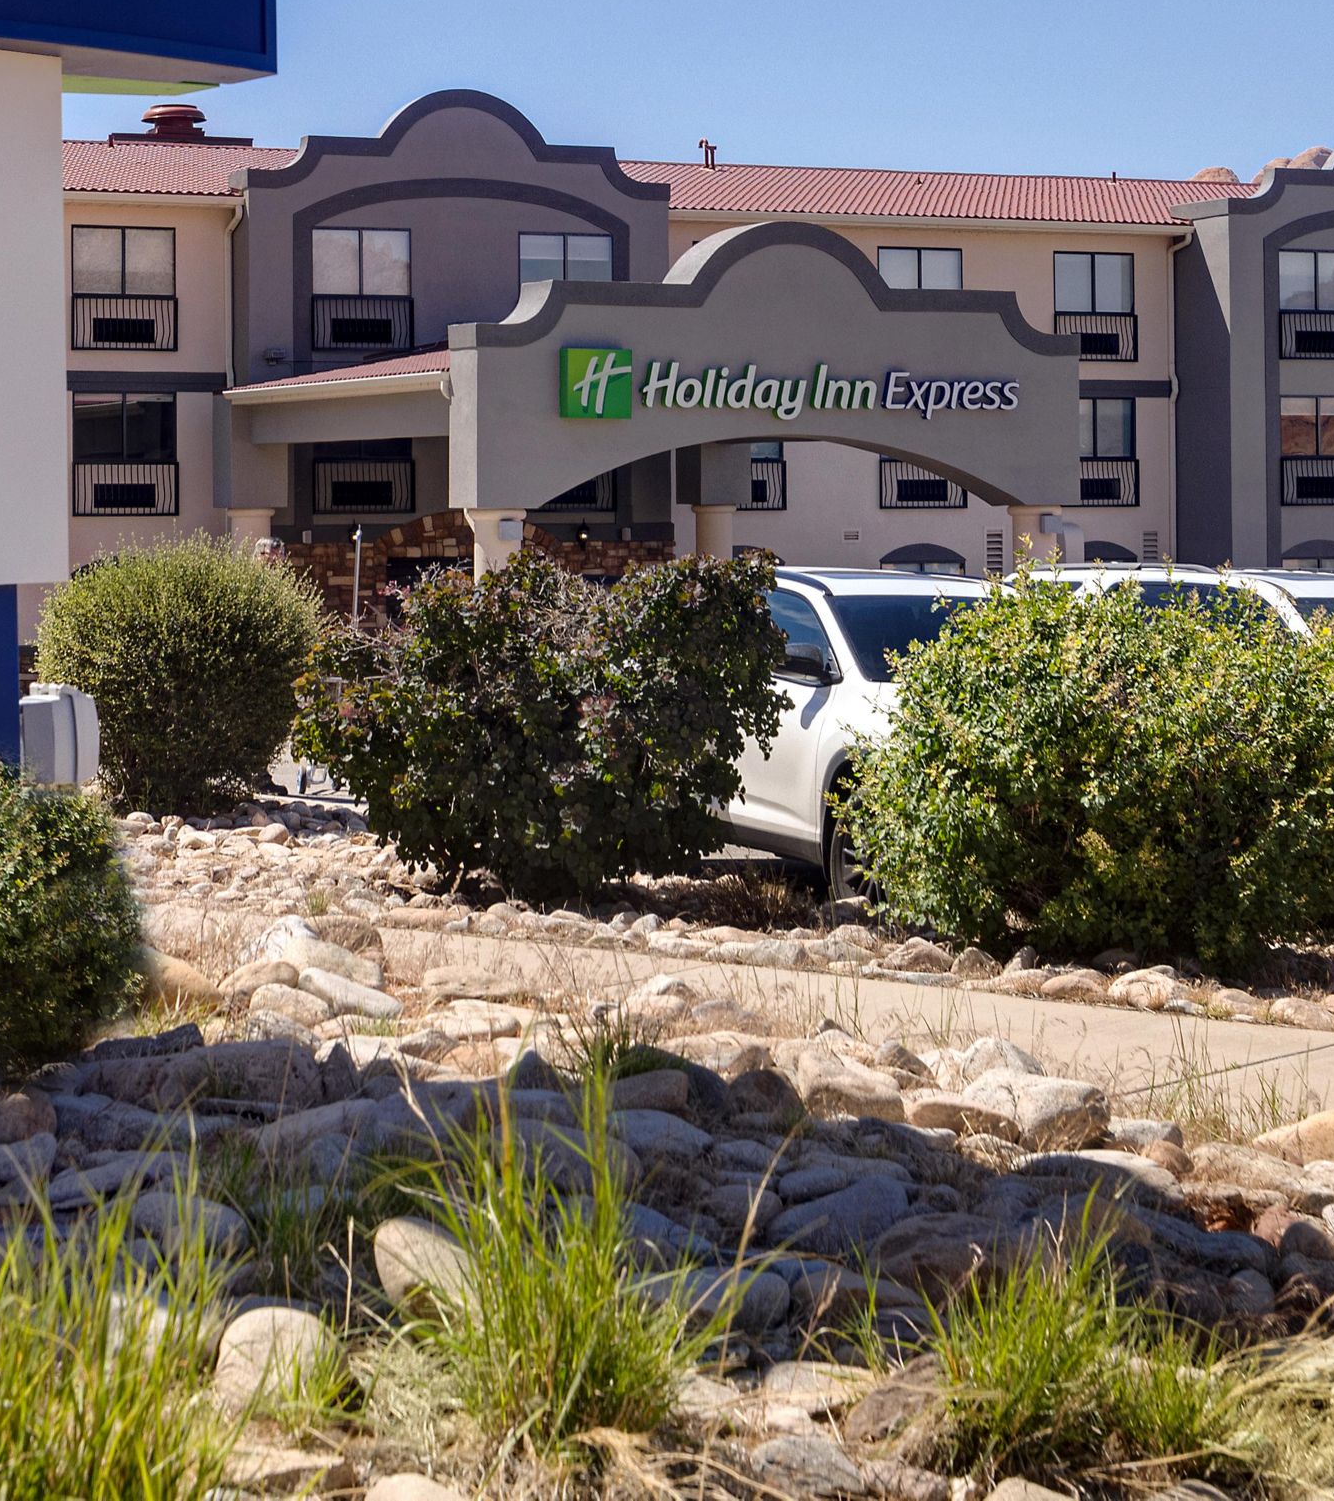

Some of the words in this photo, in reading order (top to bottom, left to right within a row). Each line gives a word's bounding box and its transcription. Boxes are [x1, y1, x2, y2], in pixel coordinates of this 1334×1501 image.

[642, 362, 808, 420] Holiday
[813, 364, 878, 410] Inn
[884, 371, 1020, 420] Express
